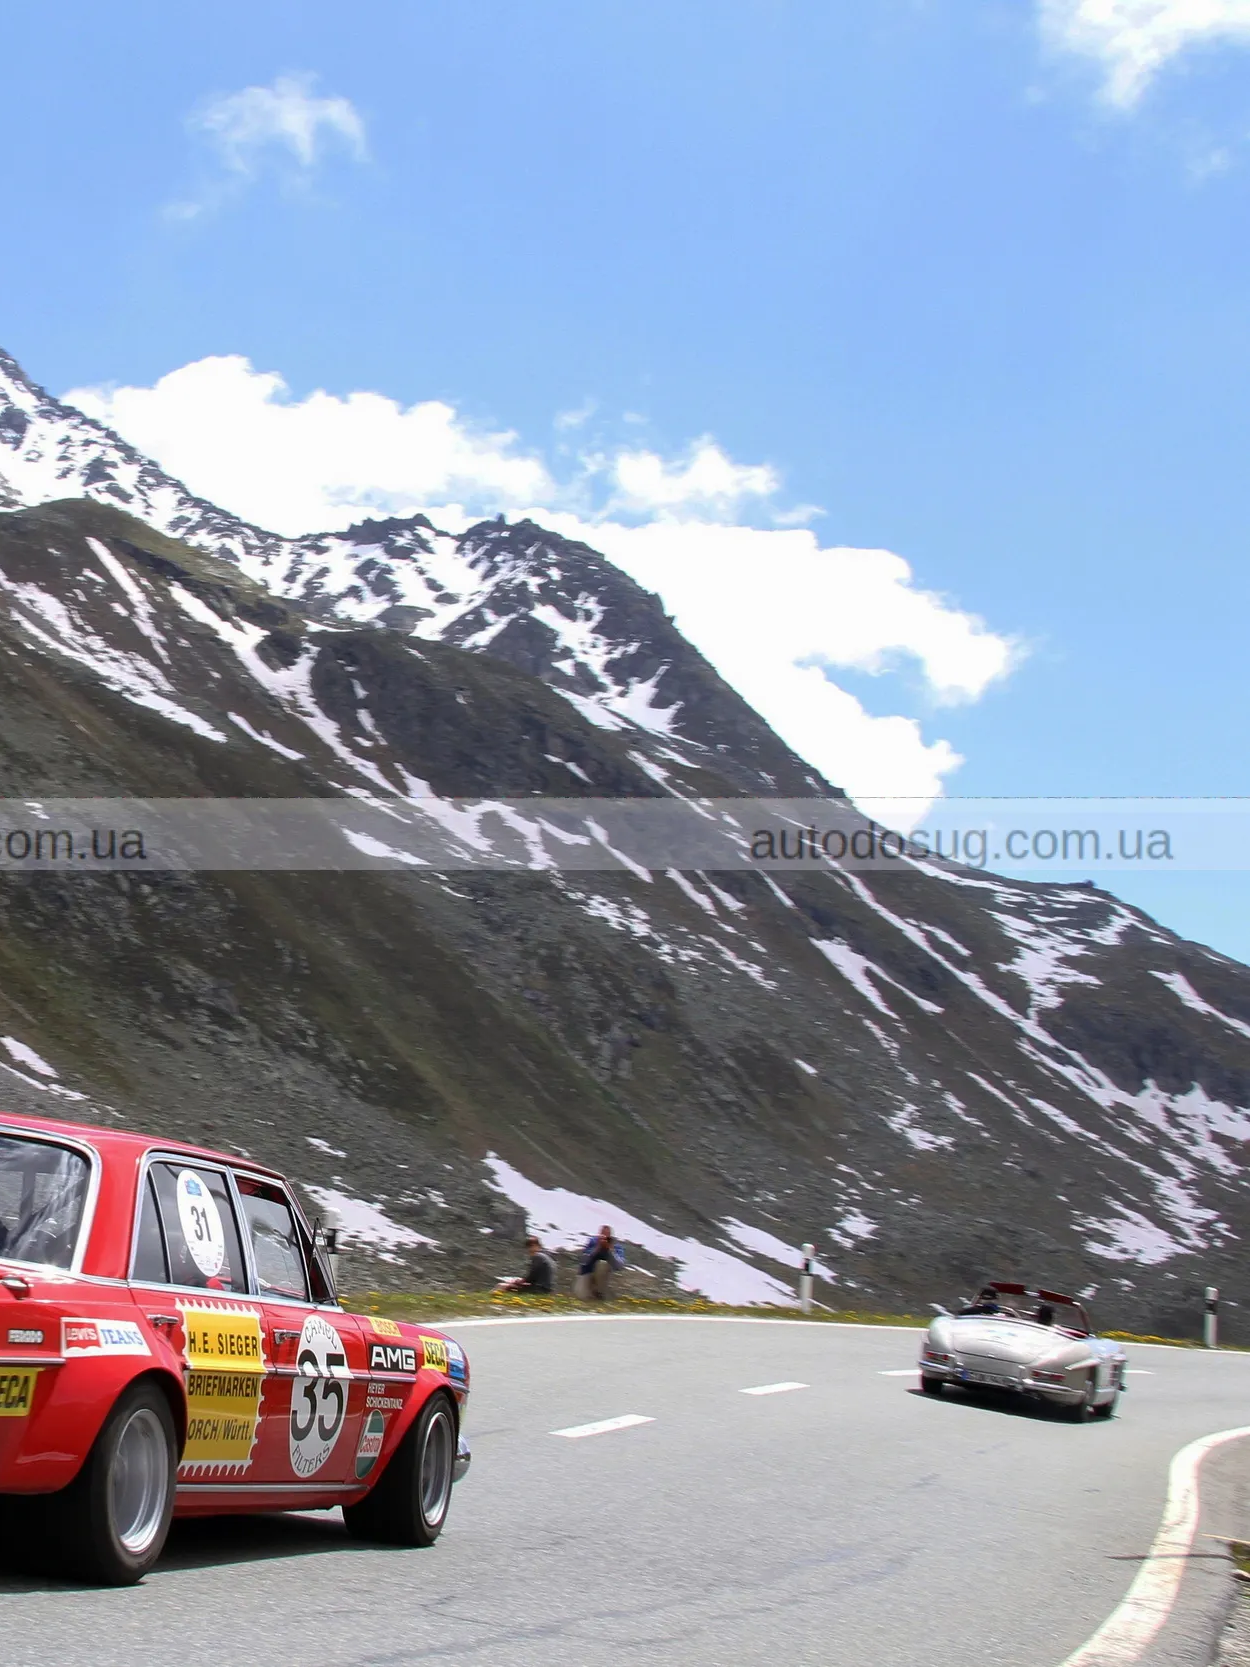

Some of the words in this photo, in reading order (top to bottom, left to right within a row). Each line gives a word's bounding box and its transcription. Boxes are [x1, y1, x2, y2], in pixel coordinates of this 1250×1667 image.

[190, 1206, 212, 1242] 31
[100, 1328, 144, 1346] JEANS
[188, 1331, 214, 1354] H.E.
[217, 1332, 258, 1357] SIEGER
[304, 1319, 338, 1350] CAMEL
[371, 1346, 416, 1371] AMG
[425, 1340, 447, 1368] SECA
[188, 1374, 258, 1397] BRIEFMARKEN
[291, 1348, 345, 1442] 35
[291, 1443, 331, 1474] FILTERS
